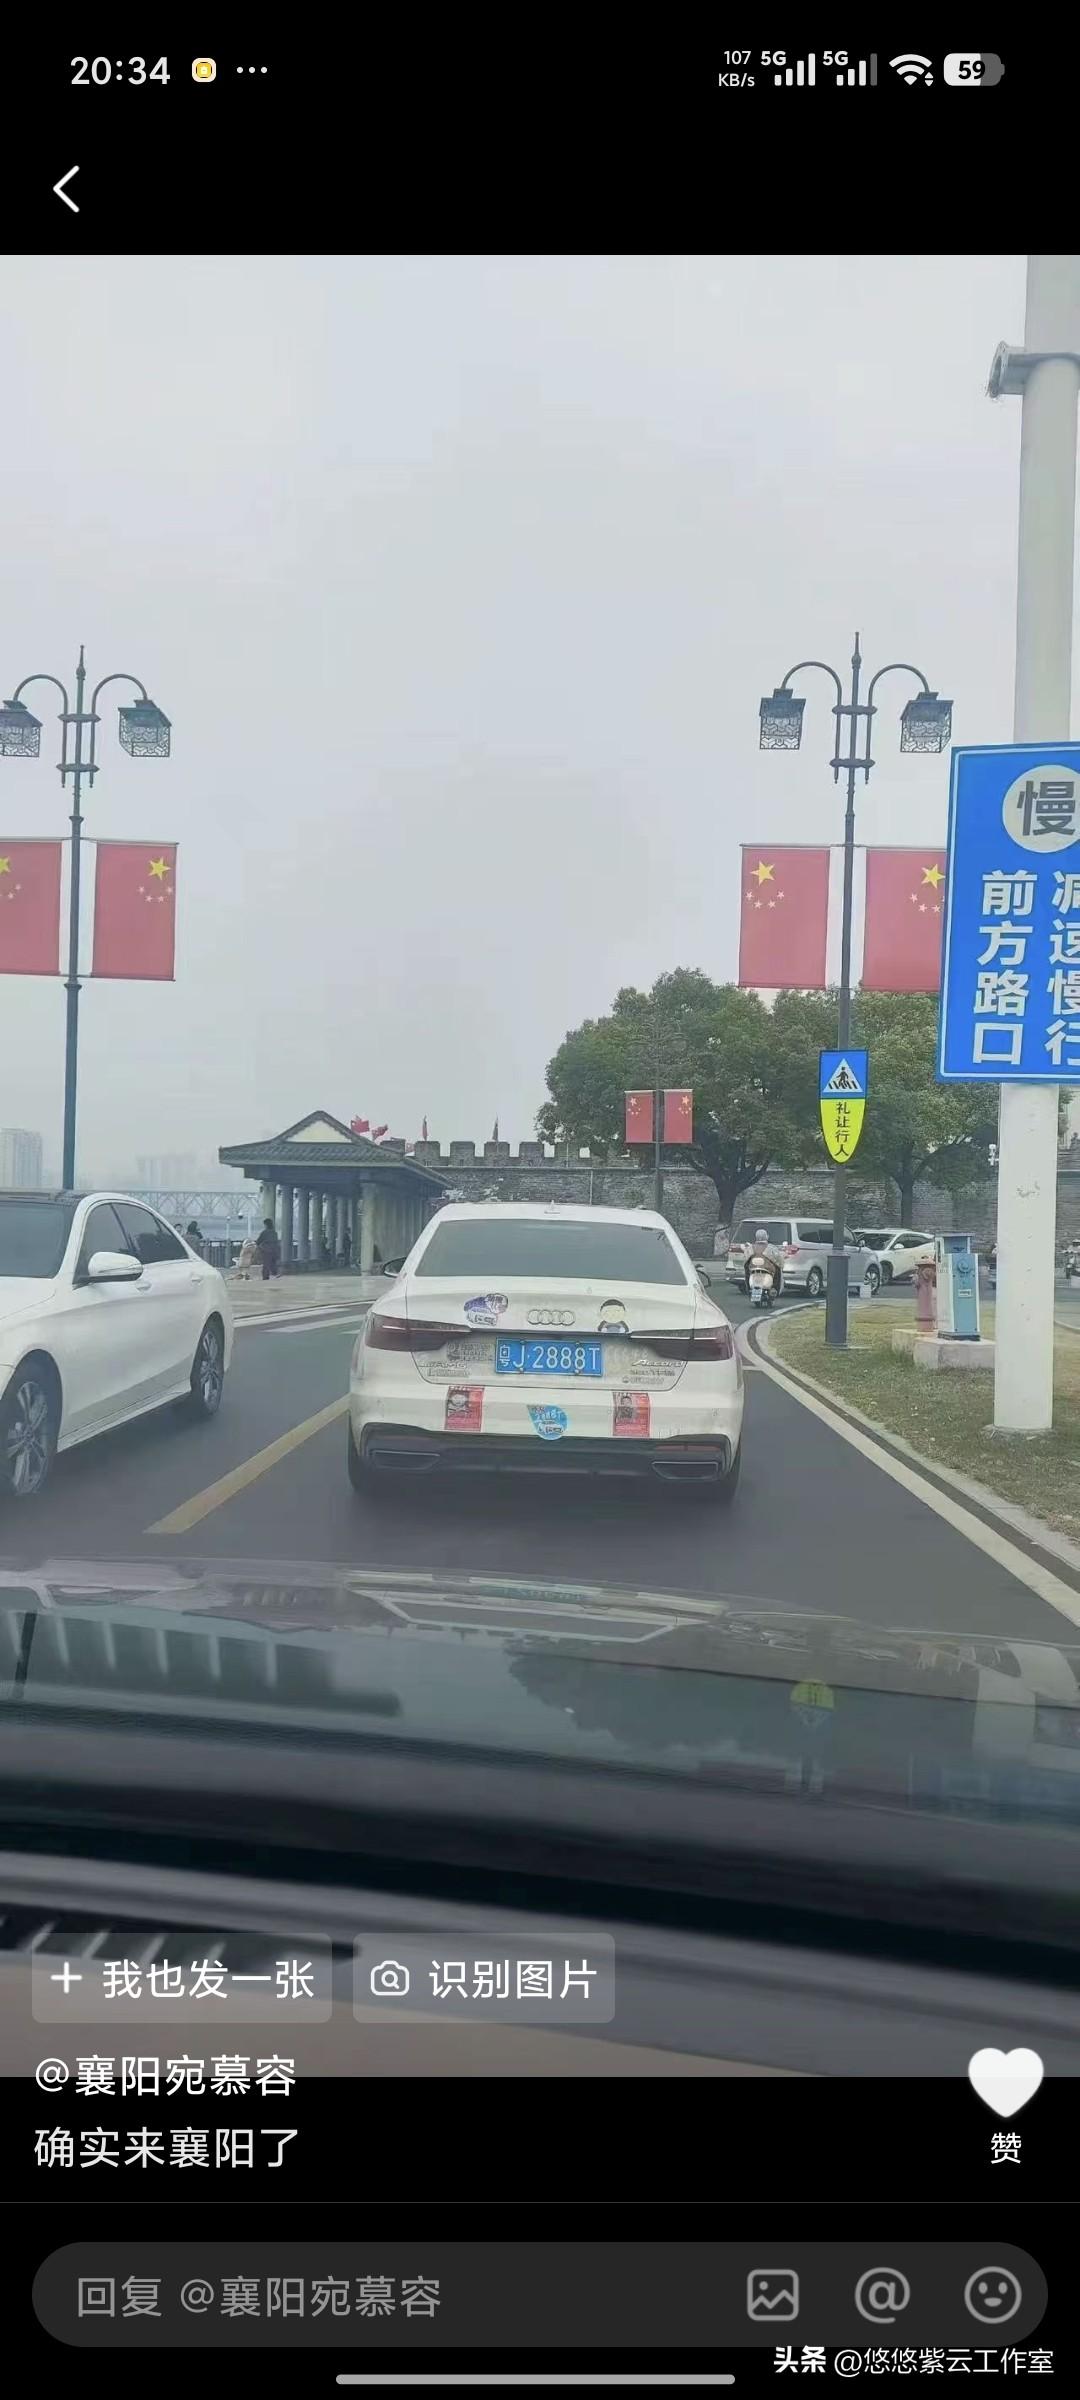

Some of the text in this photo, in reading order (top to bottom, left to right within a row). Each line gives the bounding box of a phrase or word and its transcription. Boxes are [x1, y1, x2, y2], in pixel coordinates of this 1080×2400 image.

[1017, 781, 1076, 836] 慢
[972, 869, 1038, 1066] 前方路口
[834, 1101, 851, 1157] 礼让行人
